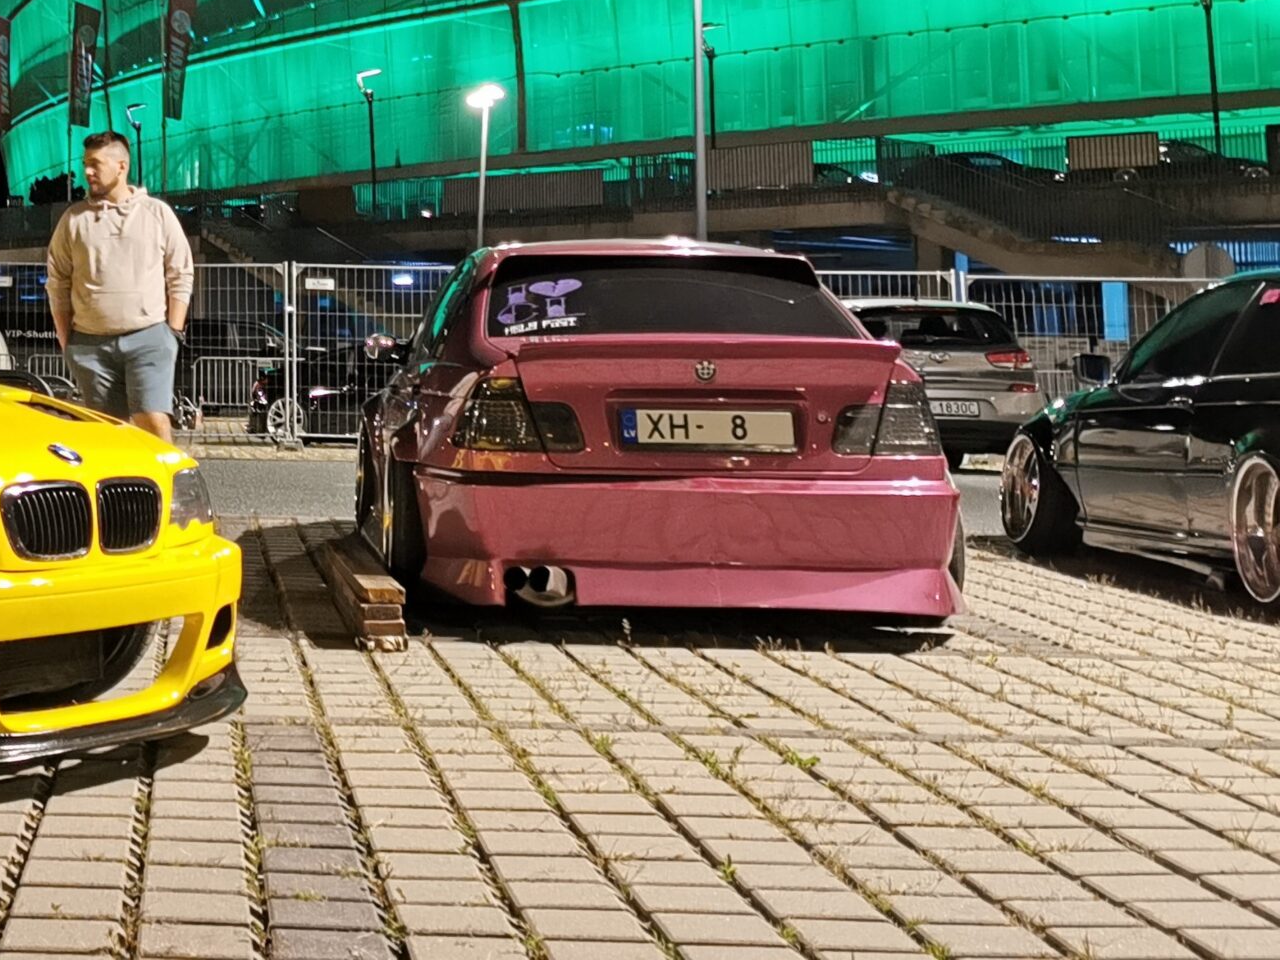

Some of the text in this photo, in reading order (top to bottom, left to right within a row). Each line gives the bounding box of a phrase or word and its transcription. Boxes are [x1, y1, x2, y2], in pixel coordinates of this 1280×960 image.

[5, 329, 58, 339] VIP-Shuttl
[623, 429, 636, 438] LV
[731, 414, 748, 441] 8
